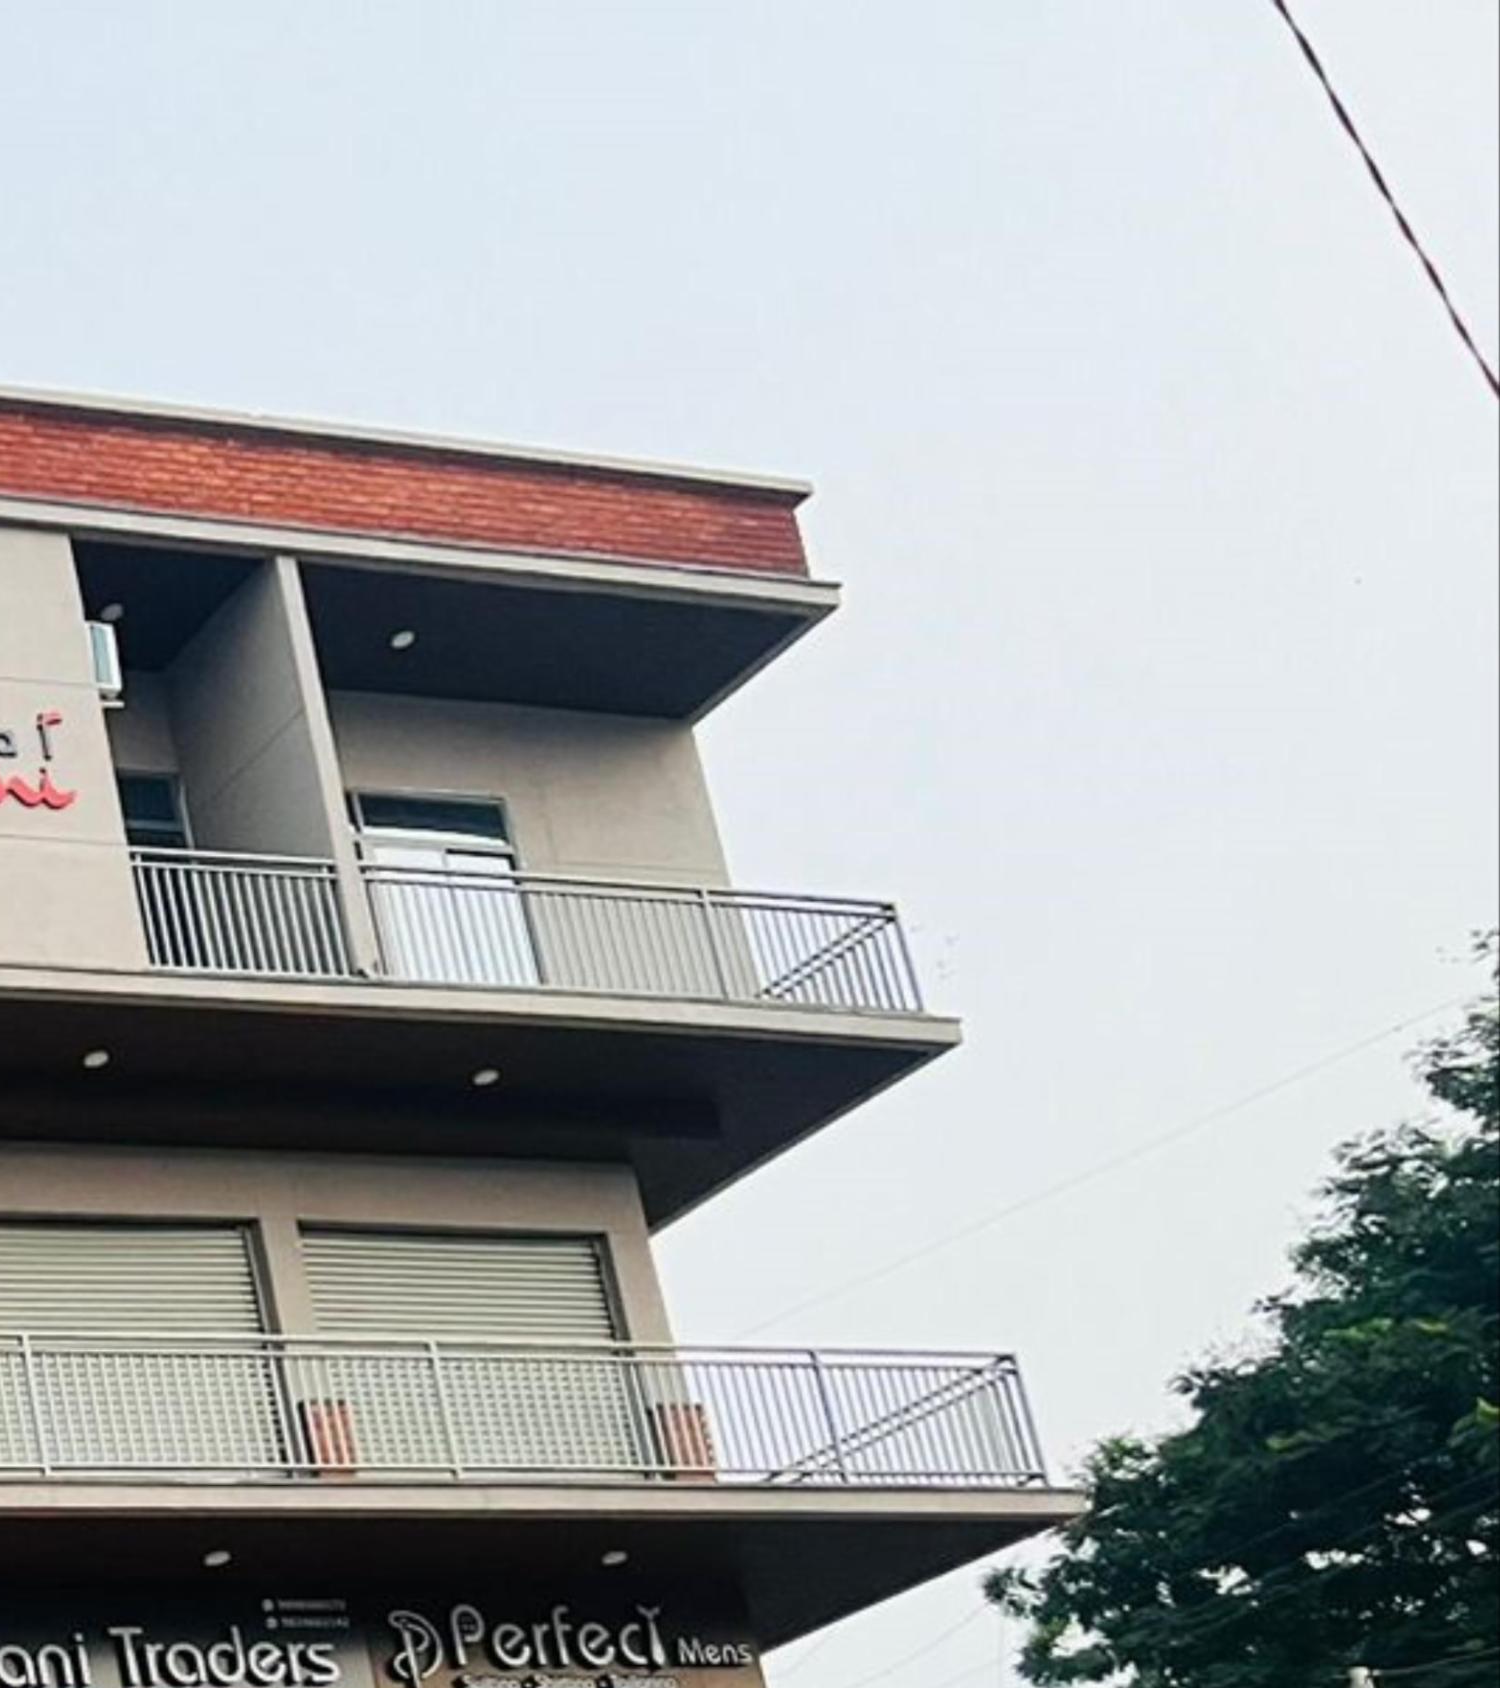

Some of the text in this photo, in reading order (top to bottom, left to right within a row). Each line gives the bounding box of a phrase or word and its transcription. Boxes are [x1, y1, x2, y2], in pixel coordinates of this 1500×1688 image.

[109, 1625, 342, 1685] Traders
[450, 1604, 665, 1667] Perfect
[677, 1636, 754, 1666] Mens
